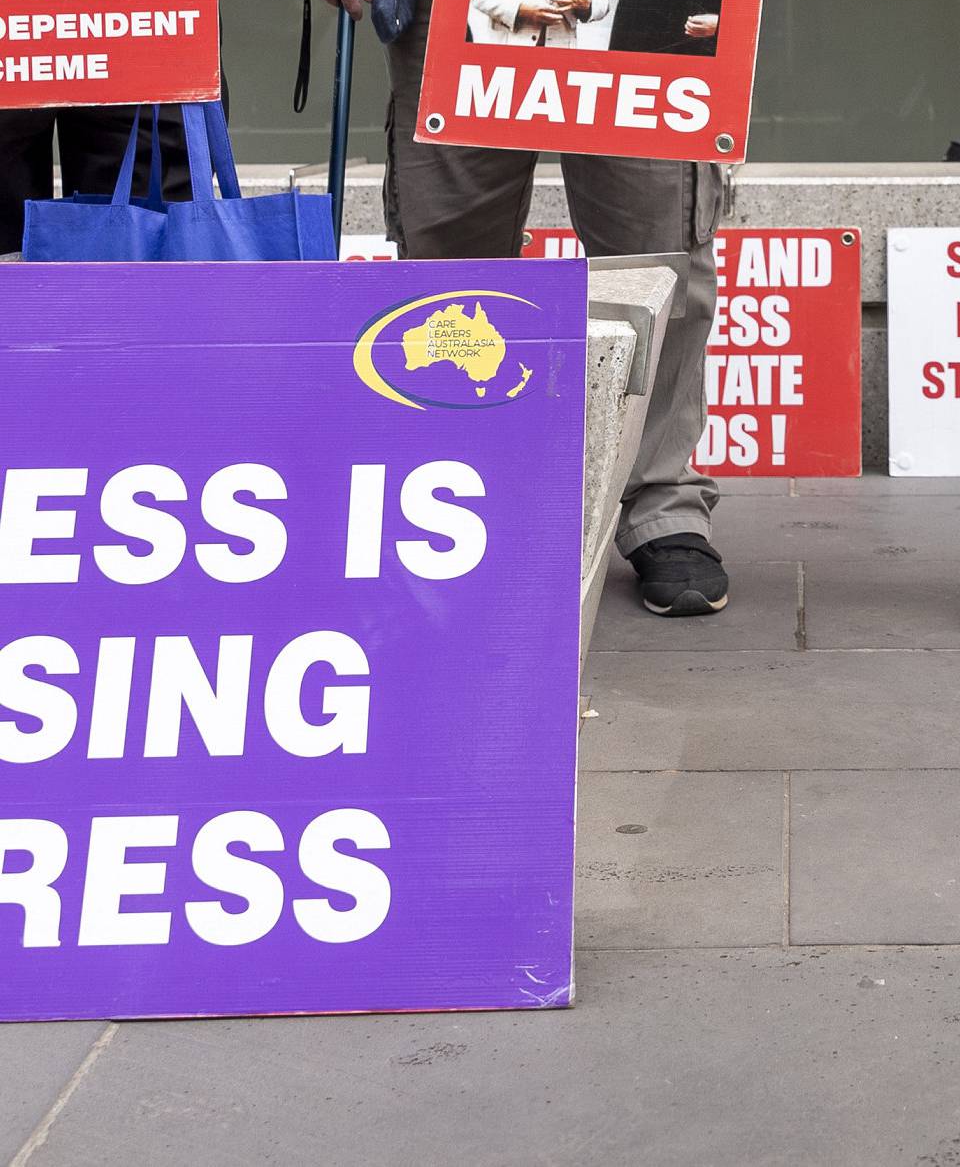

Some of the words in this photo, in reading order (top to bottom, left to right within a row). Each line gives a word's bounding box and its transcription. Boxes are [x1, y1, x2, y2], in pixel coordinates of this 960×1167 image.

[0, 10, 200, 41] EPENDENT
[0, 54, 109, 82] HEME
[455, 64, 711, 133] MATES
[736, 237, 832, 287] AND
[428, 320, 456, 329] CARE
[428, 329, 471, 338] LEAVERS
[427, 339, 496, 348] AUSTRALASIA
[427, 348, 481, 358] NETWORK
[689, 414, 759, 467] DS
[771, 414, 787, 466] !
[345, 459, 488, 580] IS
